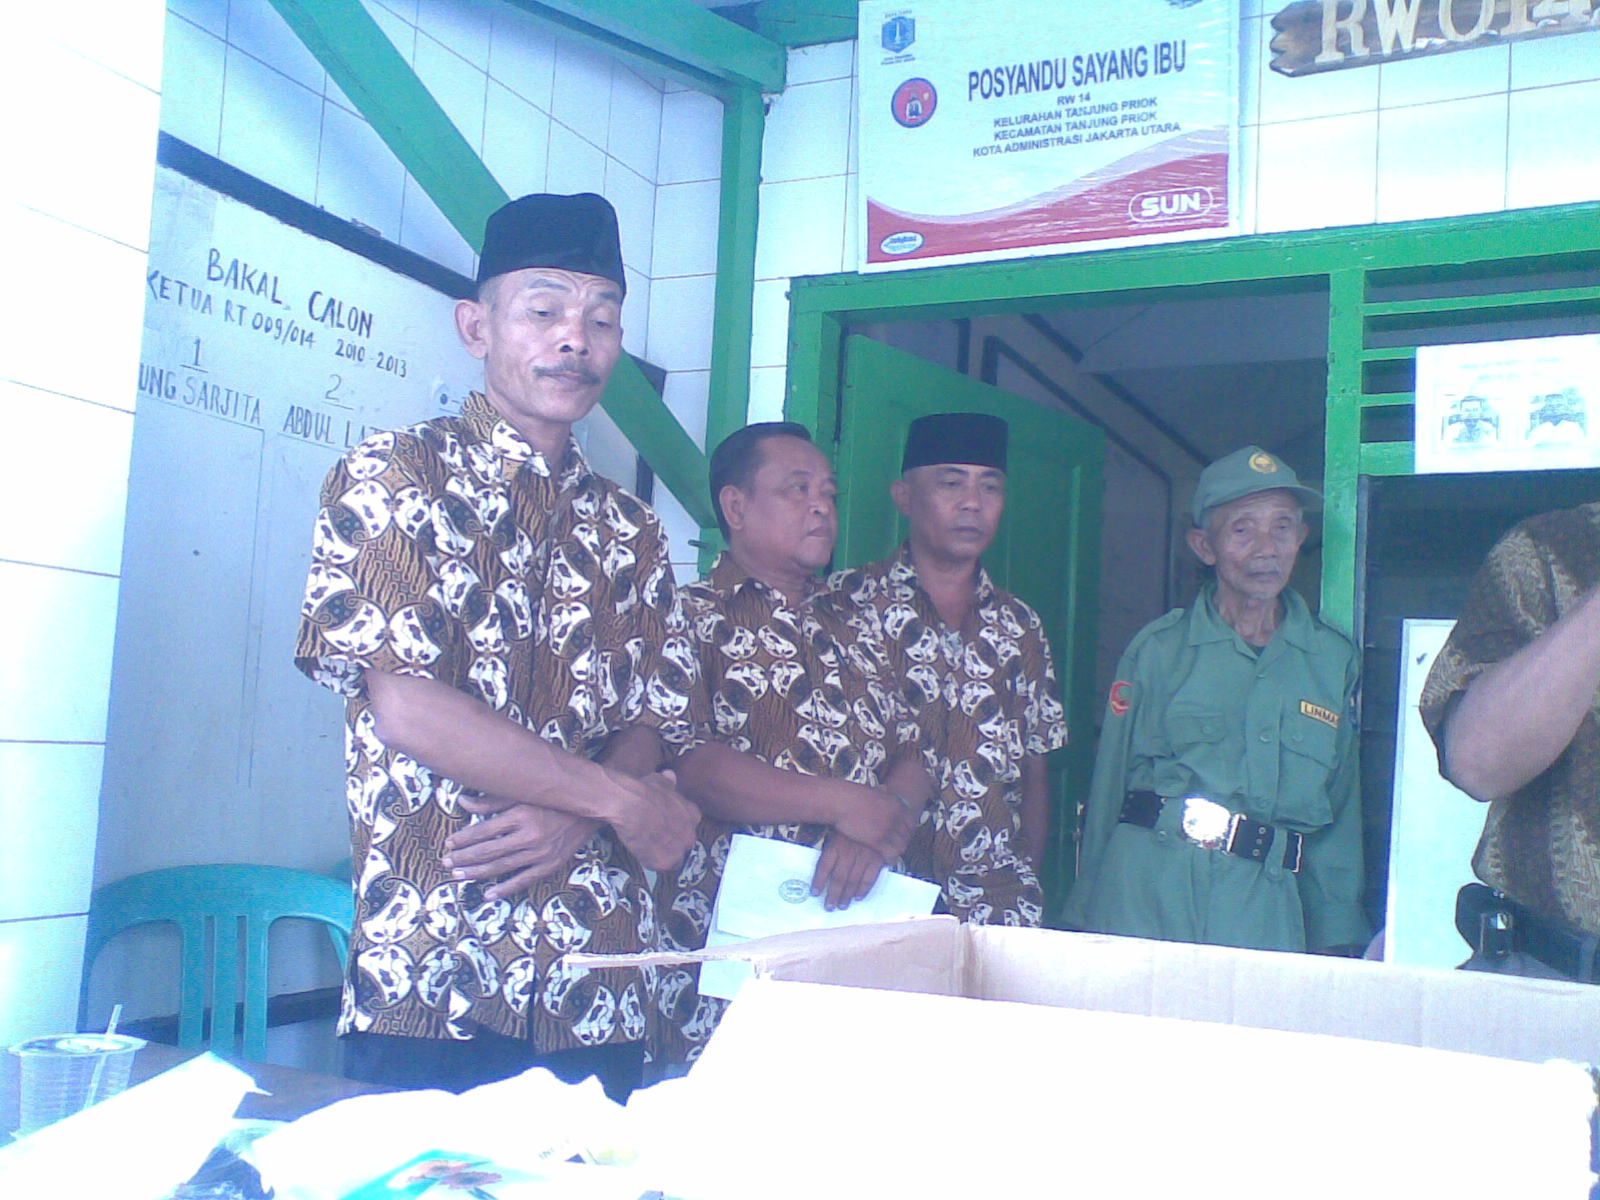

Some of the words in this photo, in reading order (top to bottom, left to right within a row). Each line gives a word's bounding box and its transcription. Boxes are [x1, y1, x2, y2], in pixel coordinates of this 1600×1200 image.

[968, 57, 1067, 102] POSYANDU
[1072, 45, 1148, 87] SAYANG
[1154, 39, 1186, 76] IBU
[994, 111, 1062, 128] KELURAHAN
[1066, 103, 1119, 118] TANJUNG
[1121, 97, 1158, 111] PRIOK
[1057, 95, 1076, 106] RW
[1079, 92, 1091, 103] 14
[973, 144, 1003, 157] KOTA
[1004, 134, 1083, 154] ADMINISTRASI
[1085, 126, 1139, 143] JAKARTA
[1141, 121, 1182, 136] UTARA
[994, 124, 1062, 141] KECAMATAN
[1066, 116, 1119, 131] TANJUNG
[1121, 111, 1158, 125] PRIOK
[1141, 192, 1201, 217] SUN
[207, 248, 282, 305] BAKAL
[308, 290, 373, 339] CALON
[192, 336, 200, 366] 1
[224, 299, 247, 327] RT
[335, 338, 366, 363] 2010
[376, 351, 408, 378] 2013
[183, 376, 261, 425] SARJITA
[324, 374, 342, 401] 2
[283, 405, 336, 444] ABDUL
